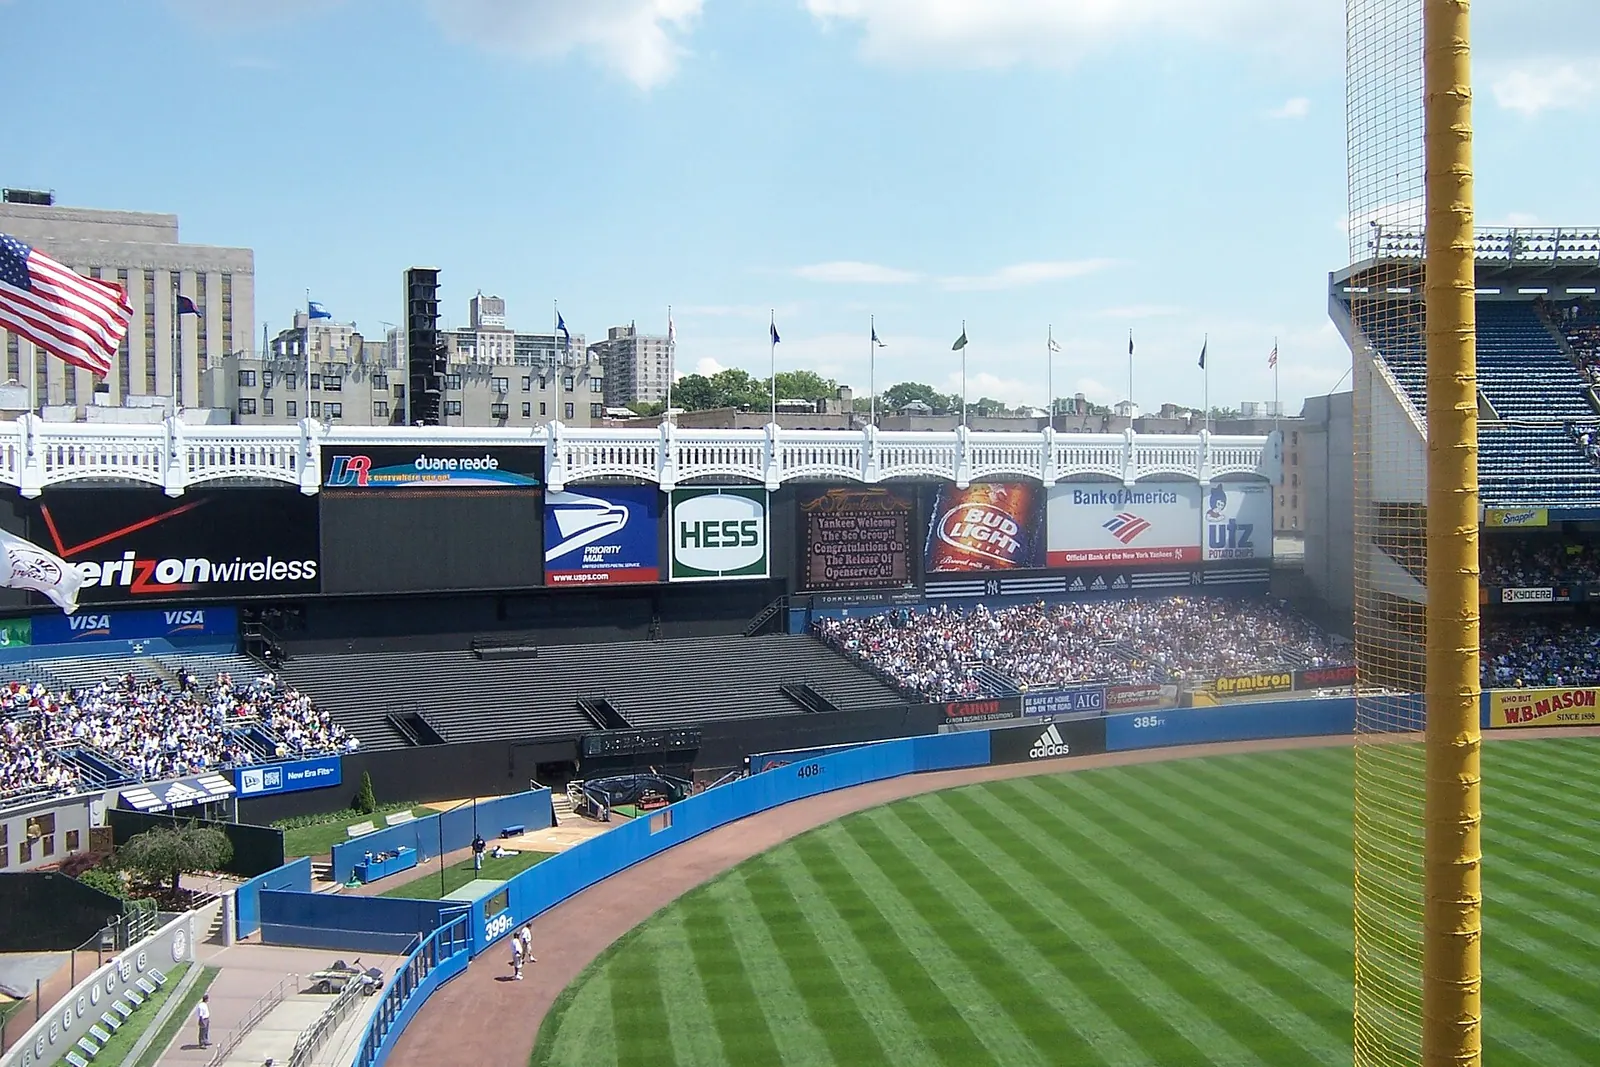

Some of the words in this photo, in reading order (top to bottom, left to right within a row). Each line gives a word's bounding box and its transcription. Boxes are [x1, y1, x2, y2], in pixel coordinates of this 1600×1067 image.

[415, 454, 458, 470] duane
[459, 455, 499, 470] reade
[373, 474, 419, 483] everywhere
[1073, 489, 1107, 505] Bank
[1109, 489, 1123, 505] of
[1123, 489, 1177, 504] America
[818, 518, 855, 529] Yankees
[857, 517, 896, 527] Welcome
[964, 508, 1018, 536] BUD
[1503, 510, 1536, 524] Snapple
[680, 520, 758, 548] HESS
[822, 530, 840, 540] The
[841, 531, 858, 540] Sco
[860, 529, 895, 541] Group!!
[950, 522, 1020, 554] LIGHT
[584, 545, 622, 554] PRIORITY
[814, 542, 888, 555] Congratulations
[890, 541, 903, 551] On
[1208, 548, 1234, 559] POTATO
[583, 554, 604, 562] MAIL
[826, 555, 843, 566] The
[846, 555, 879, 565] Release
[881, 554, 892, 563] Of
[1065, 554, 1087, 562] Official
[1088, 553, 1104, 561] Bank
[1122, 552, 1135, 560] New
[1149, 551, 1173, 559] Yankees
[67, 551, 209, 594] erizon
[553, 573, 609, 583] www.usps.com
[825, 566, 880, 578] Openserver
[68, 614, 111, 630] VISA
[164, 610, 205, 624] VISA
[1216, 674, 1291, 690] Armitron
[1033, 697, 1047, 705] SAFE
[1047, 696, 1053, 704] AT
[1076, 693, 1100, 708] AIG
[1500, 695, 1516, 704] WHO
[1518, 694, 1532, 703] BUT
[945, 700, 1000, 717] Canon
[1133, 715, 1158, 729] 385
[1556, 713, 1579, 721] SINCE
[1029, 743, 1069, 759] adidas
[287, 771, 304, 780] New
[304, 769, 316, 778] Era
[797, 763, 819, 779] 408
[149, 804, 168, 813] NEW
[171, 800, 193, 809] YORK
[197, 793, 230, 804] YANKEES
[485, 914, 507, 942] 399
